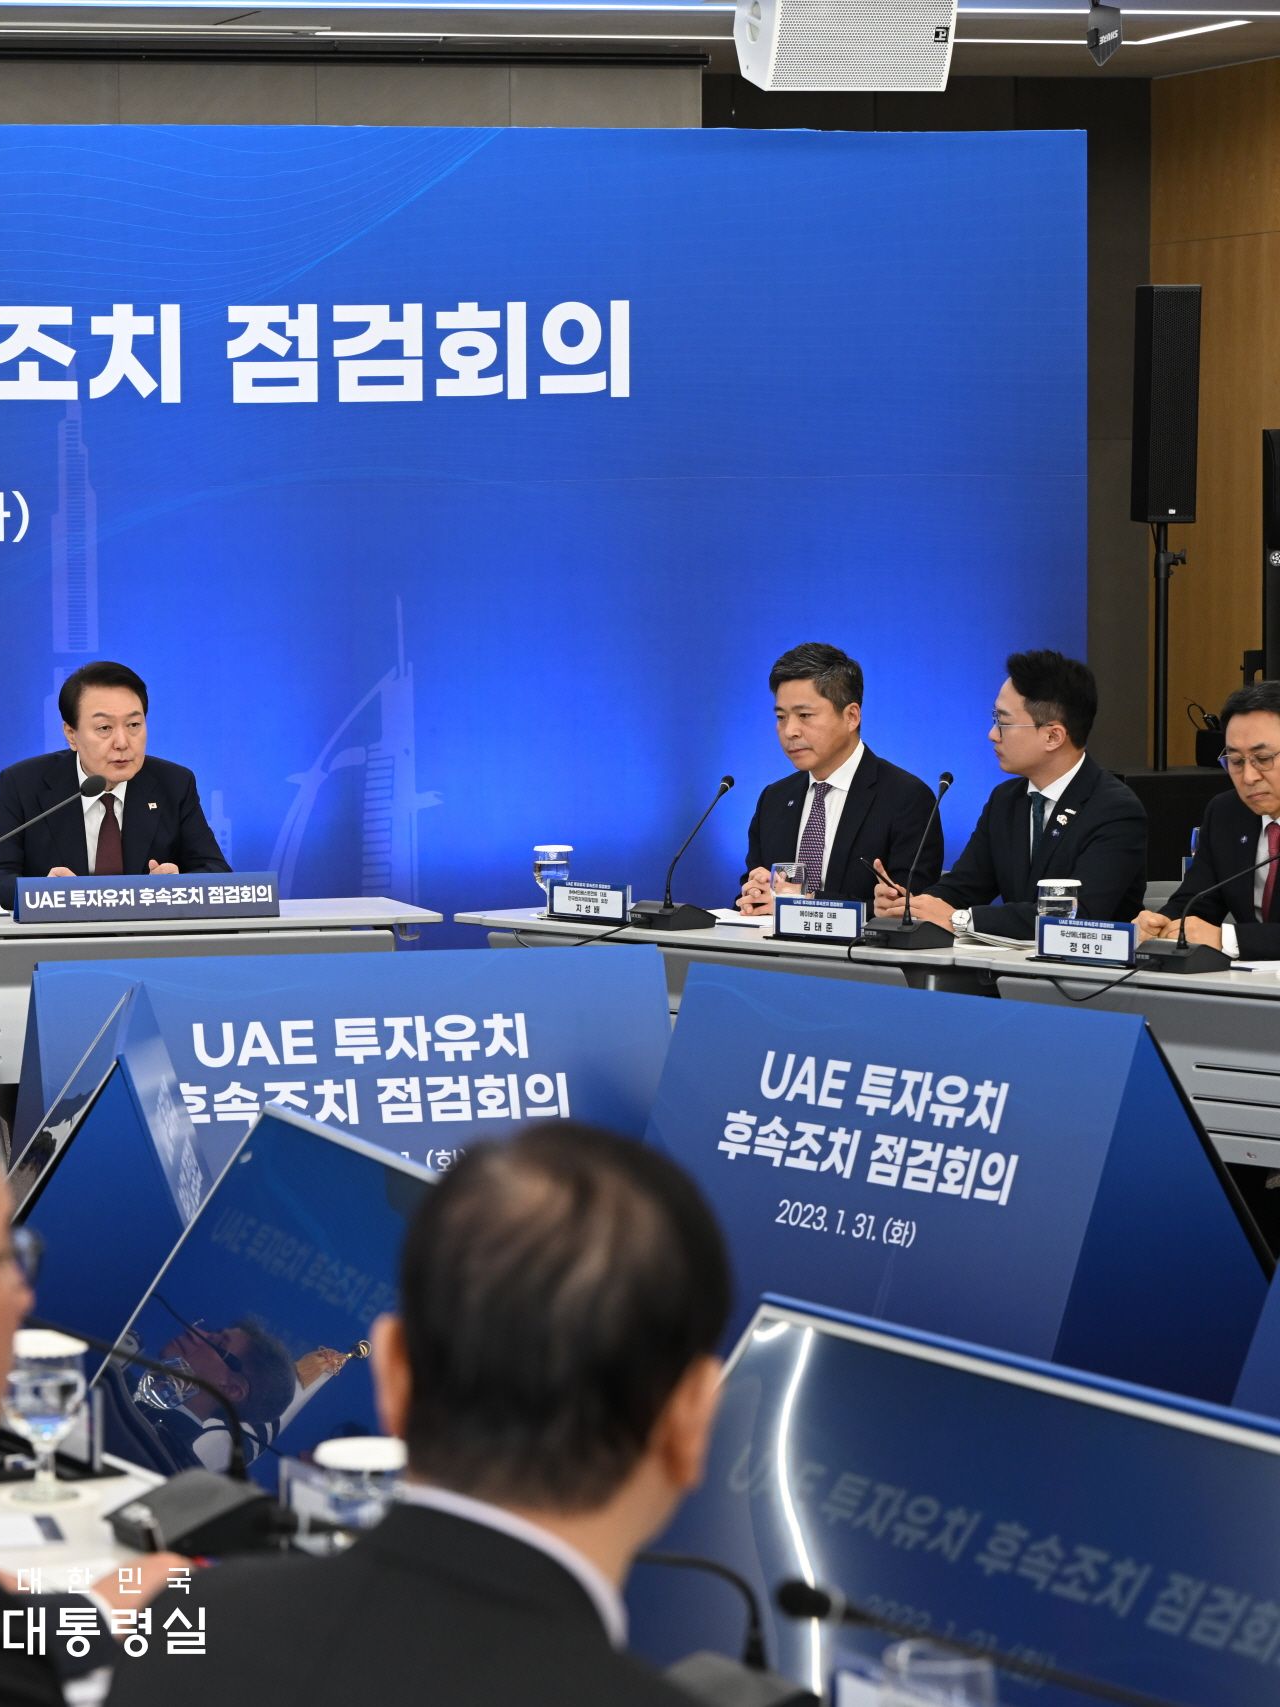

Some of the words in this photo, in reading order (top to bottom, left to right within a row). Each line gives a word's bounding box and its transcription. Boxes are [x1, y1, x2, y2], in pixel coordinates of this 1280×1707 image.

[227, 300, 631, 404] 점검회의
[25, 891, 66, 909] UAE
[70, 889, 136, 908] 투자유치
[140, 887, 204, 906] 후속조치
[208, 885, 273, 904] 점검회의
[193, 1021, 318, 1068] UAE
[334, 1013, 529, 1065] 투자유치
[376, 1073, 571, 1124] 점검회의
[760, 1050, 852, 1109] UAE
[856, 1063, 1010, 1134] 투자유치
[717, 1109, 862, 1169] 후속조치
[866, 1133, 1019, 1206] 점검회의
[775, 1199, 829, 1232] 2023.
[836, 1209, 847, 1236] 1.
[851, 1213, 877, 1241] 31.
[882, 1217, 917, 1248] (화)
[820, 1471, 982, 1564] 투자유치
[974, 1521, 1154, 1619] 후속조치
[1144, 1571, 1280, 1667] 점검회
